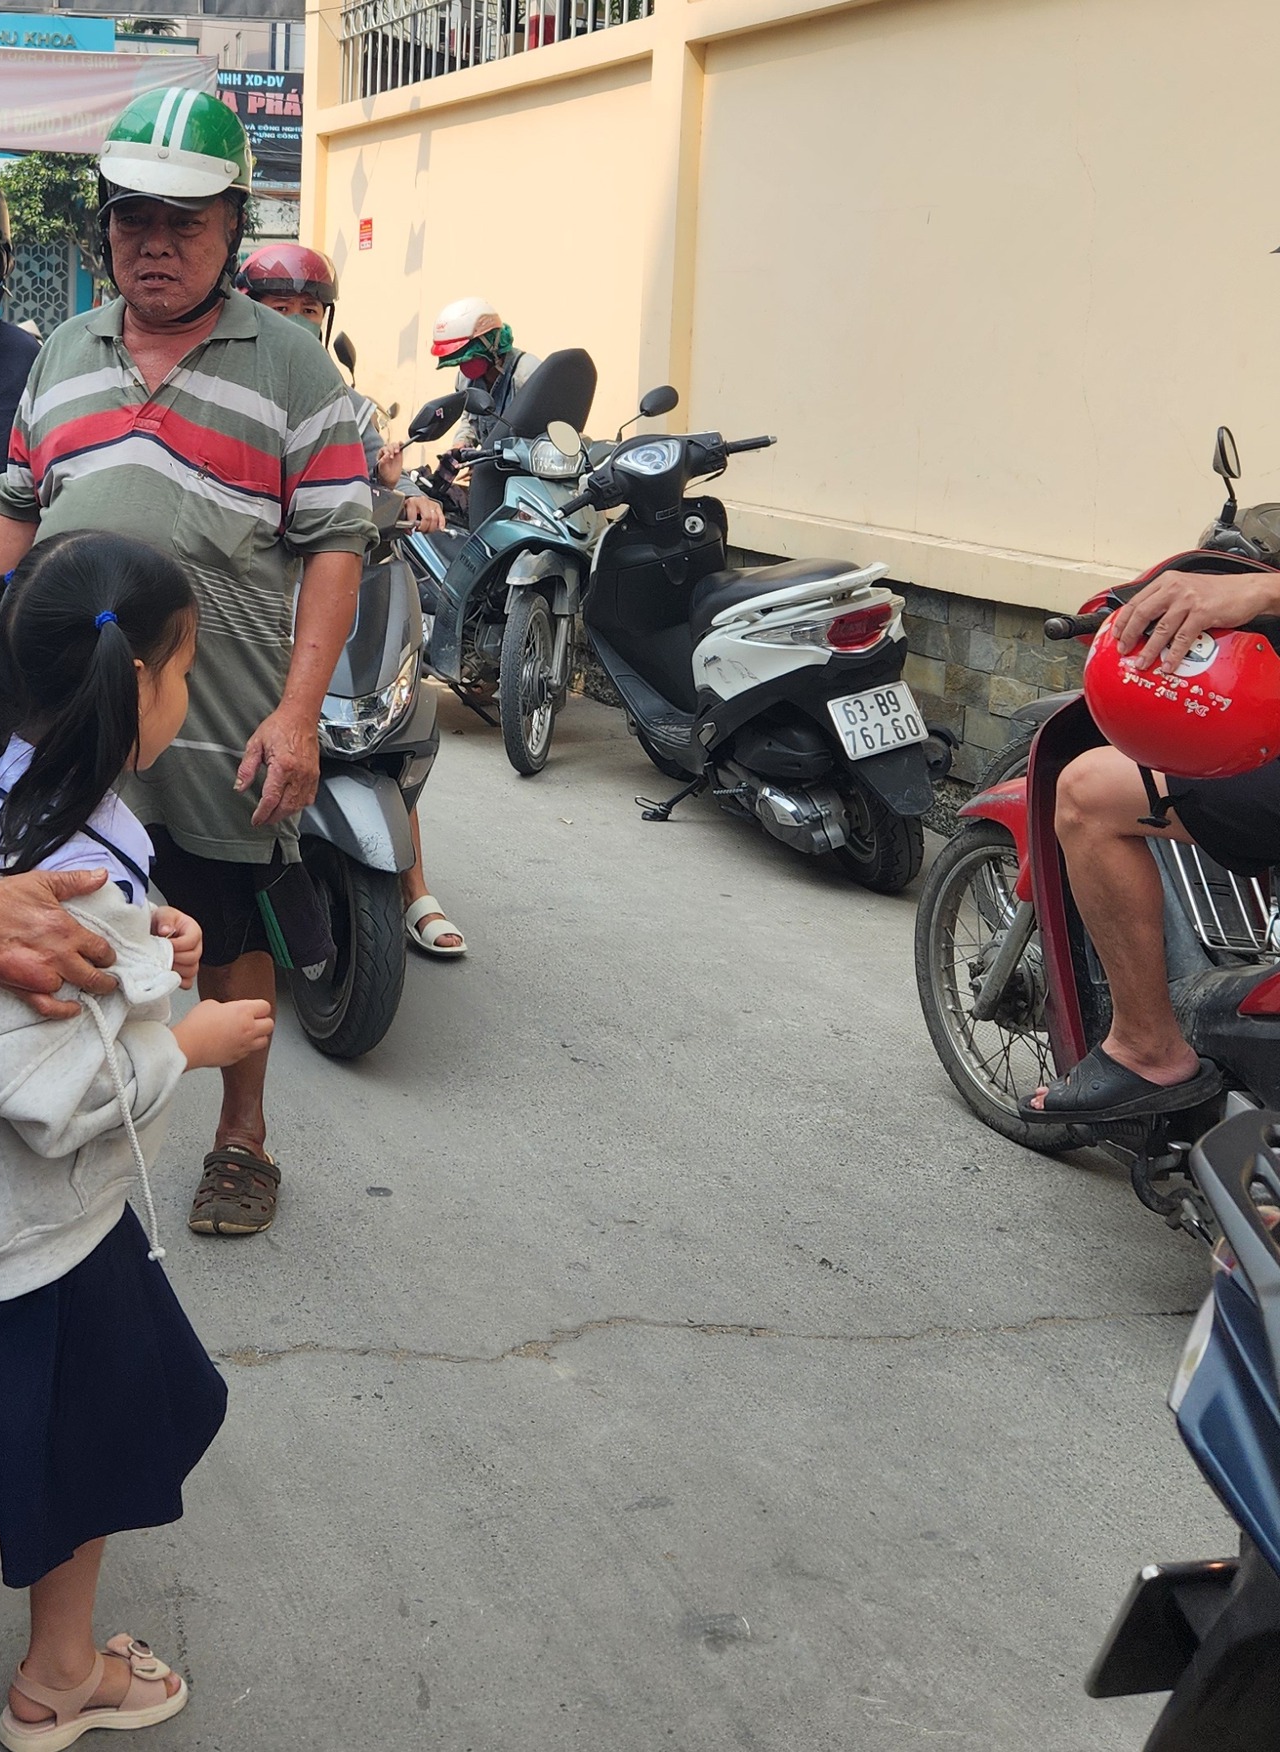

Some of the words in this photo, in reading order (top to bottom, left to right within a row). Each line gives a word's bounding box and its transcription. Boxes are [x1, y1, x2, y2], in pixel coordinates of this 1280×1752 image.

[23, 31, 78, 49] KHOA
[247, 88, 303, 116] PHÁ
[841, 689, 902, 726] 63-B9
[844, 713, 921, 756] 762.60
